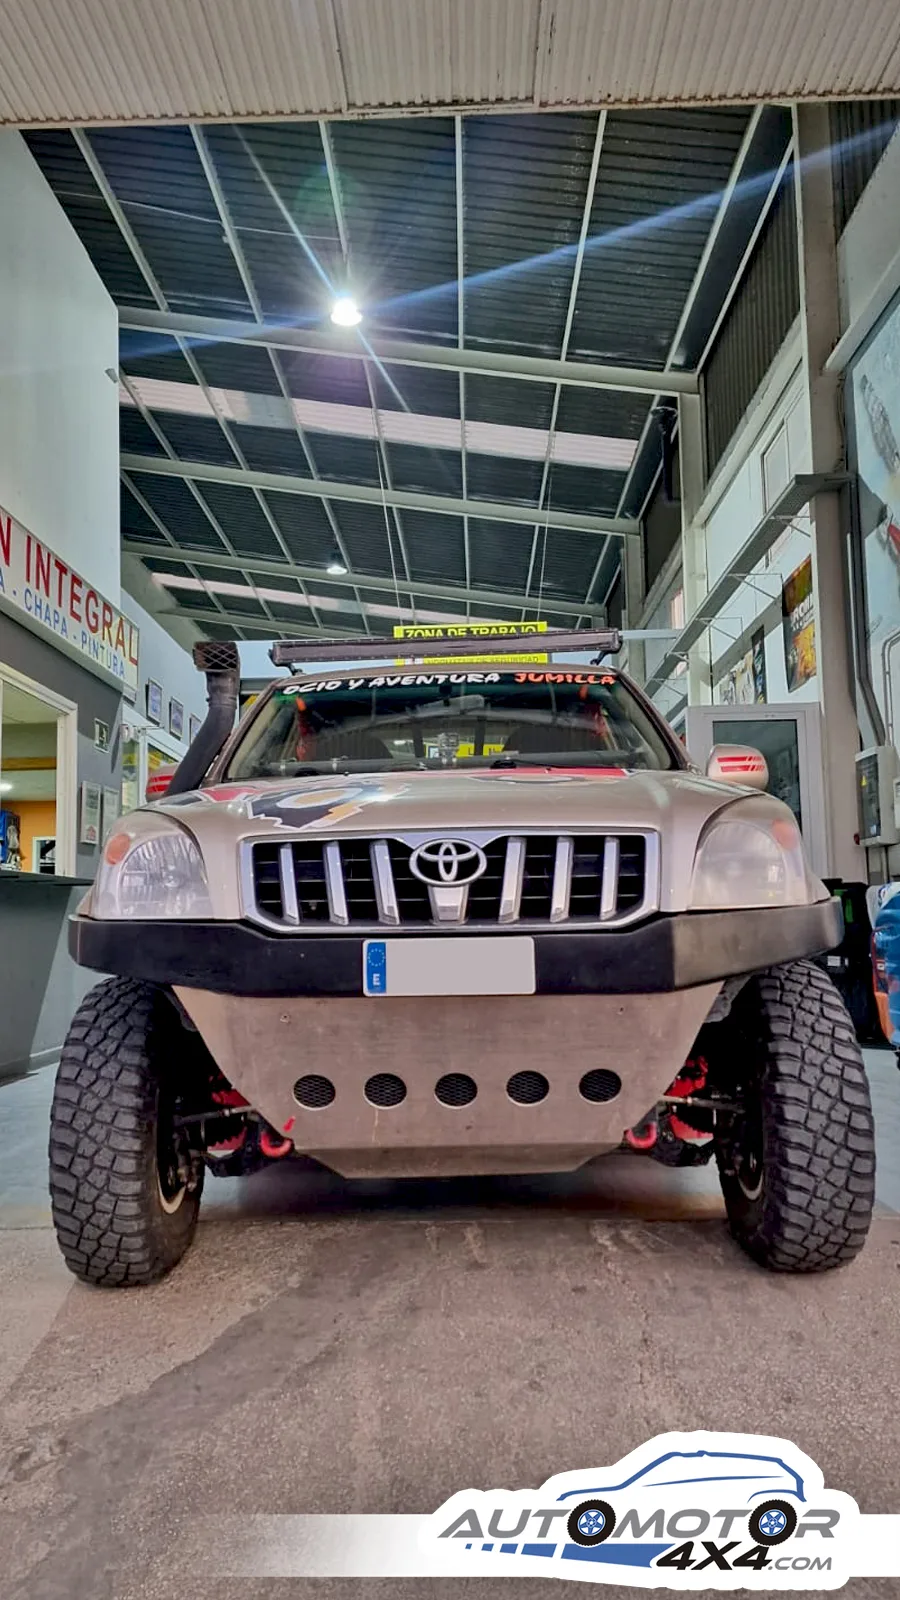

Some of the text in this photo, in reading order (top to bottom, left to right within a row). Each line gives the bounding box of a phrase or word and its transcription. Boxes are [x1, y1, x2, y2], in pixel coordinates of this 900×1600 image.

[25, 534, 138, 666] INTEGRAL
[24, 588, 68, 639] CHAPA
[81, 630, 125, 679] PINTURA
[368, 674, 500, 688] AVENTURA
[514, 672, 615, 685] JUMILLA
[373, 973, 381, 986] E
